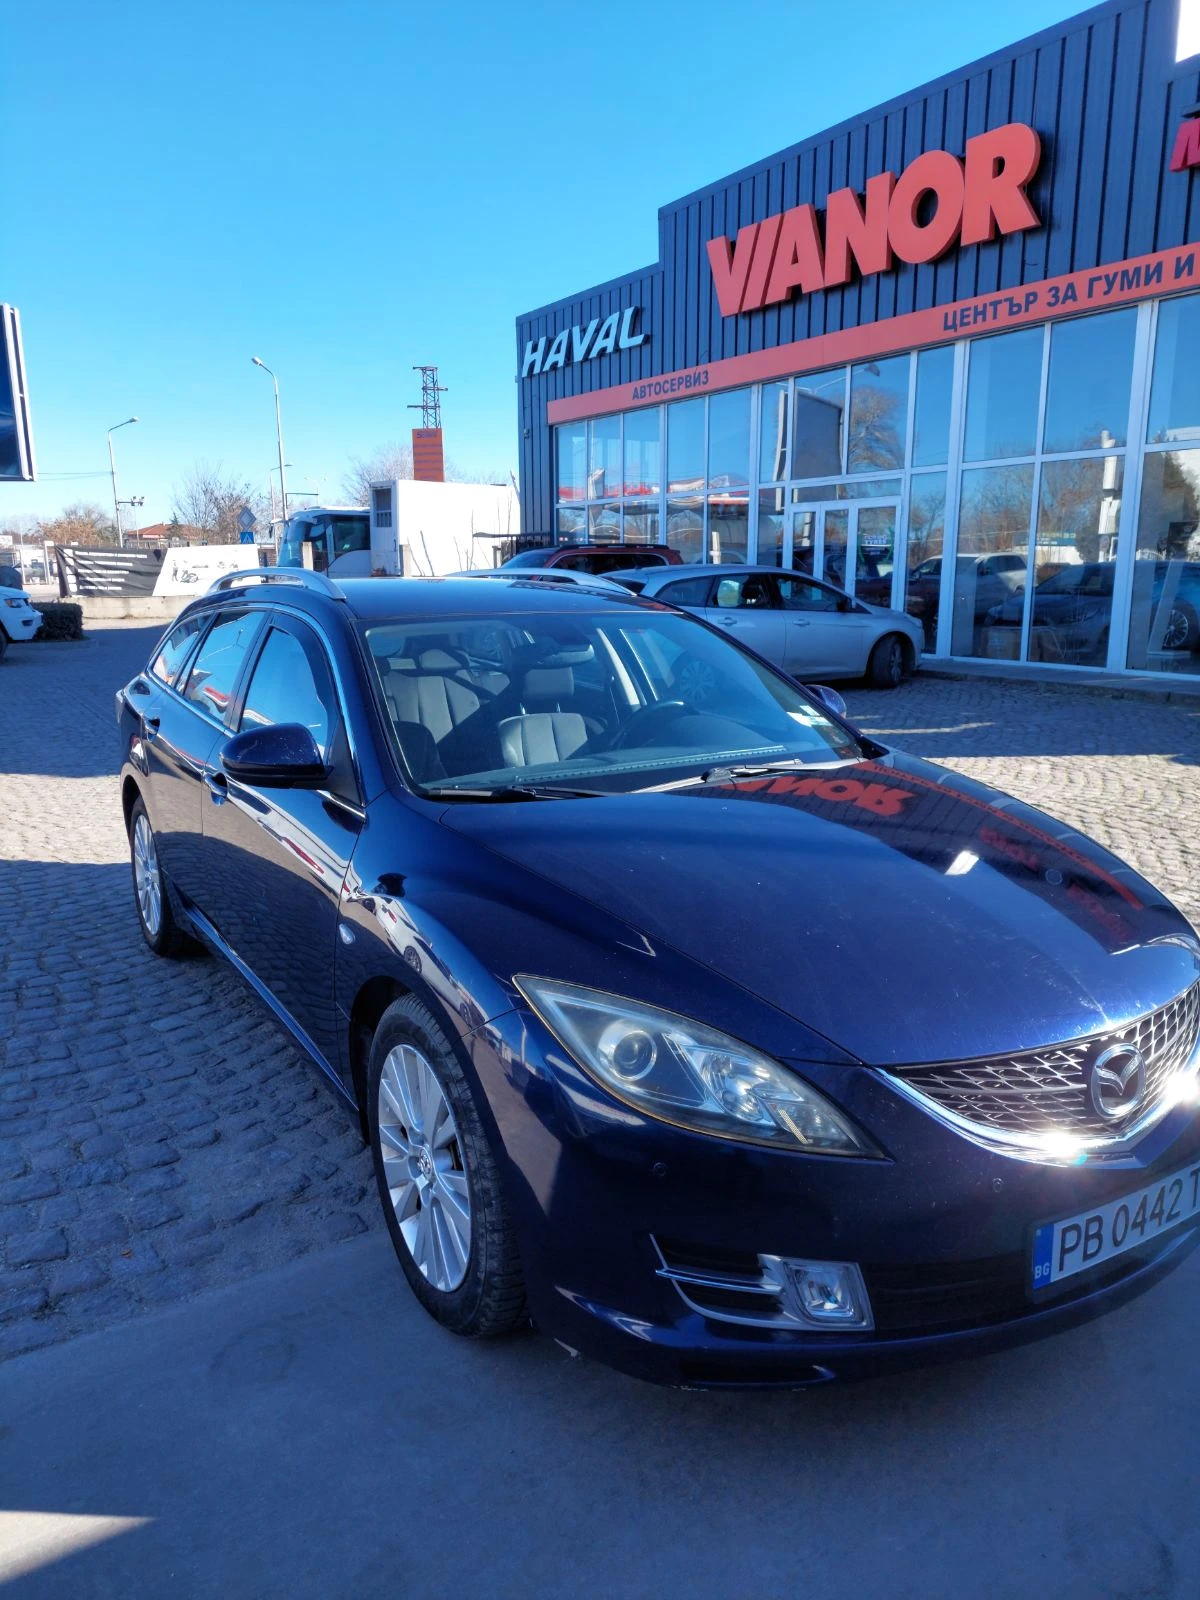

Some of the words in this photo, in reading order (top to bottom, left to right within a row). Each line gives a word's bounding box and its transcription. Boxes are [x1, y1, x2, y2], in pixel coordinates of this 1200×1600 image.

[706, 122, 1041, 318] VIANOR
[943, 291, 1038, 333] ЦЕНТЪР
[1046, 282, 1078, 307] ЗА
[1087, 260, 1163, 299] ГУМИ
[1174, 253, 1195, 279] И
[521, 306, 645, 378] HAVAL
[632, 370, 709, 400] АВТОСЕРВИЗ
[1058, 1215, 1104, 1272] PB
[1112, 1178, 1183, 1248] 0442
[1034, 1262, 1051, 1280] BG
